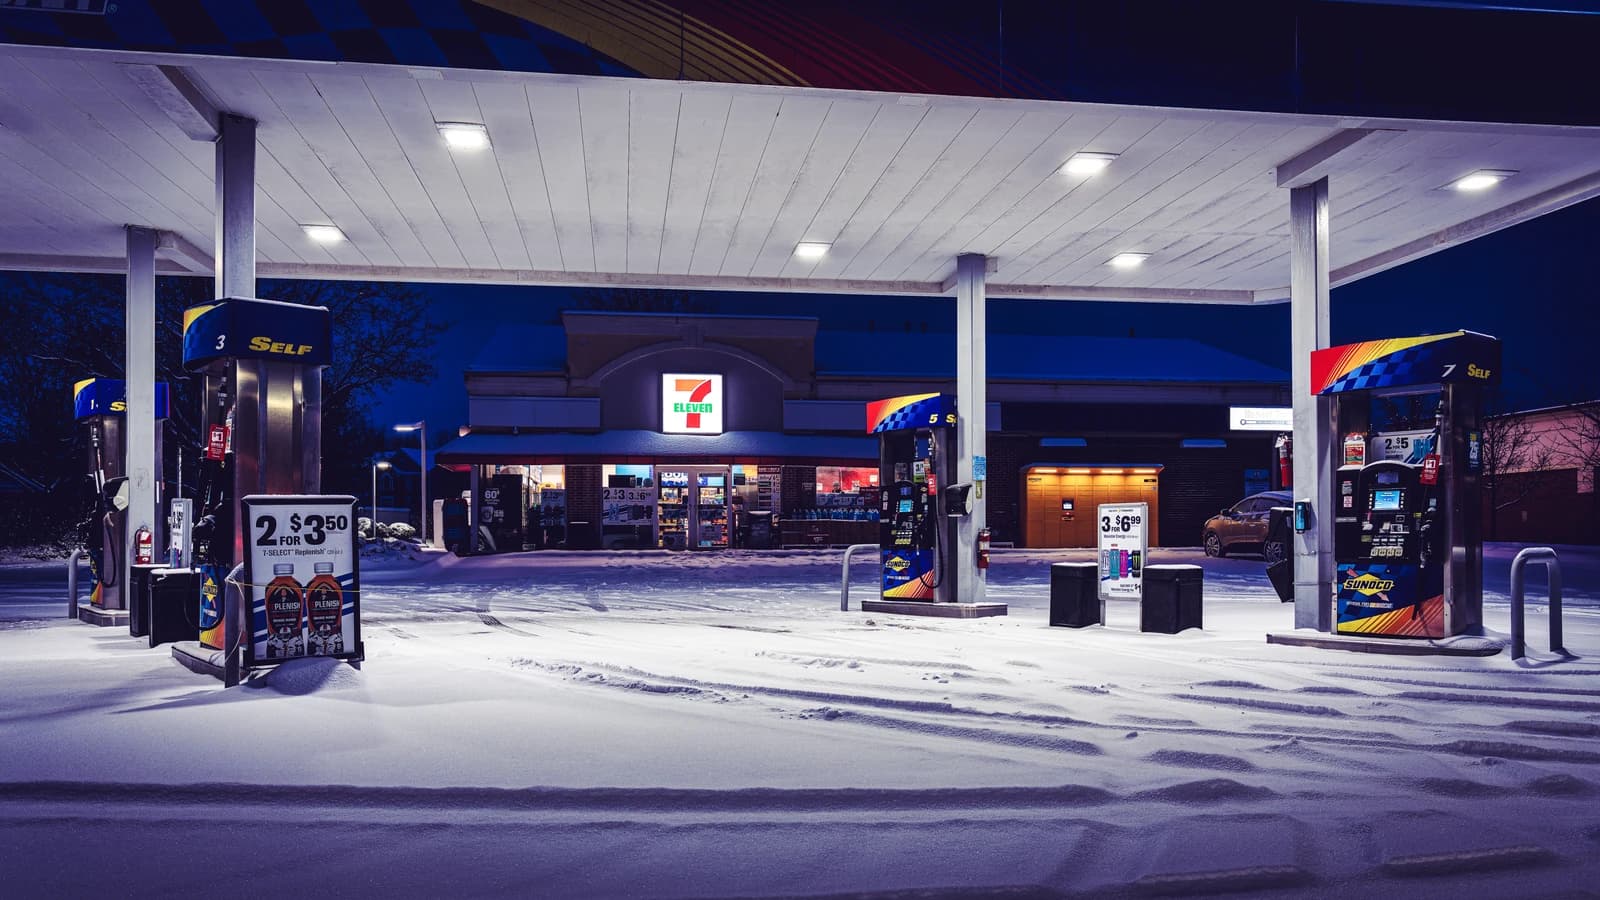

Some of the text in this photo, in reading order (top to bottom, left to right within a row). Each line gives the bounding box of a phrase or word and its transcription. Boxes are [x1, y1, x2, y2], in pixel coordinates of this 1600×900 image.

[215, 334, 226, 350] 3
[248, 336, 313, 356] SELF
[1441, 363, 1457, 378] 7
[1467, 362, 1491, 379] SELF
[675, 379, 712, 428] 7
[928, 413, 939, 424] 5
[1385, 438, 1392, 450] 2
[256, 515, 277, 546] 2
[279, 535, 301, 546] FOR
[1101, 516, 1111, 532] 3
[1344, 579, 1393, 590] SUNOCO
